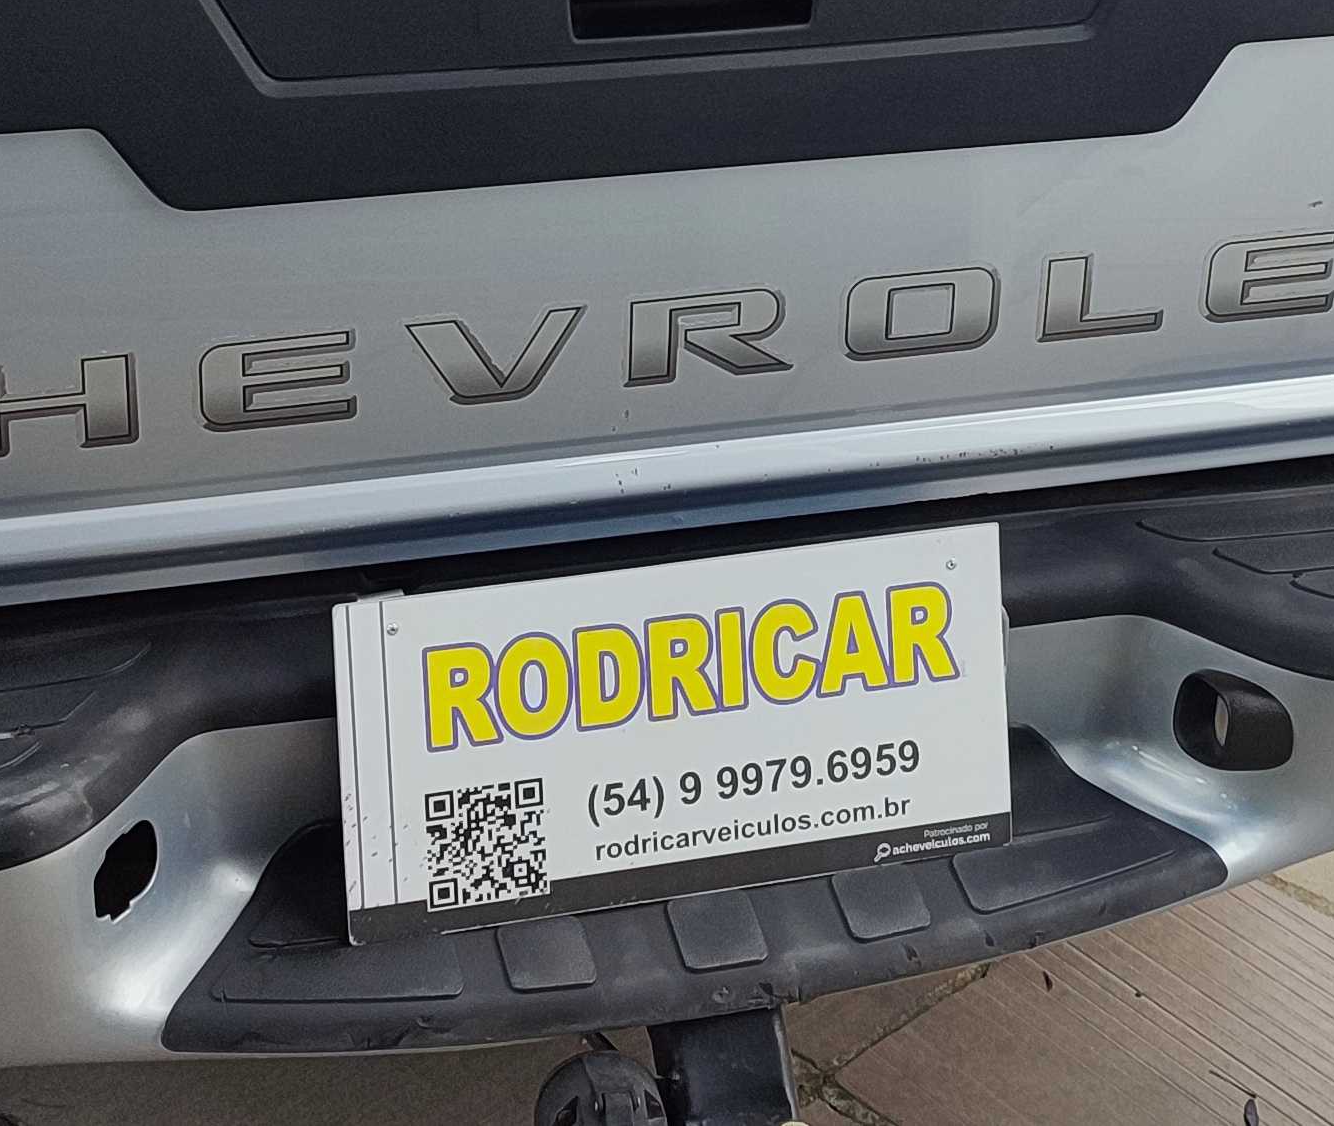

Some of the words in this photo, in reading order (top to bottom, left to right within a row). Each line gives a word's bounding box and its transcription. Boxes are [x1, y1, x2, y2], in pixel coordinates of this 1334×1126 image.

[421, 581, 960, 753] RODRICAR
[587, 775, 665, 827] (54)
[679, 771, 702, 805] 9
[716, 739, 921, 801] 9979.6959
[594, 795, 911, 861] rodricarveiculos.com.br
[923, 824, 973, 838] Patrocinado
[974, 821, 989, 832] por
